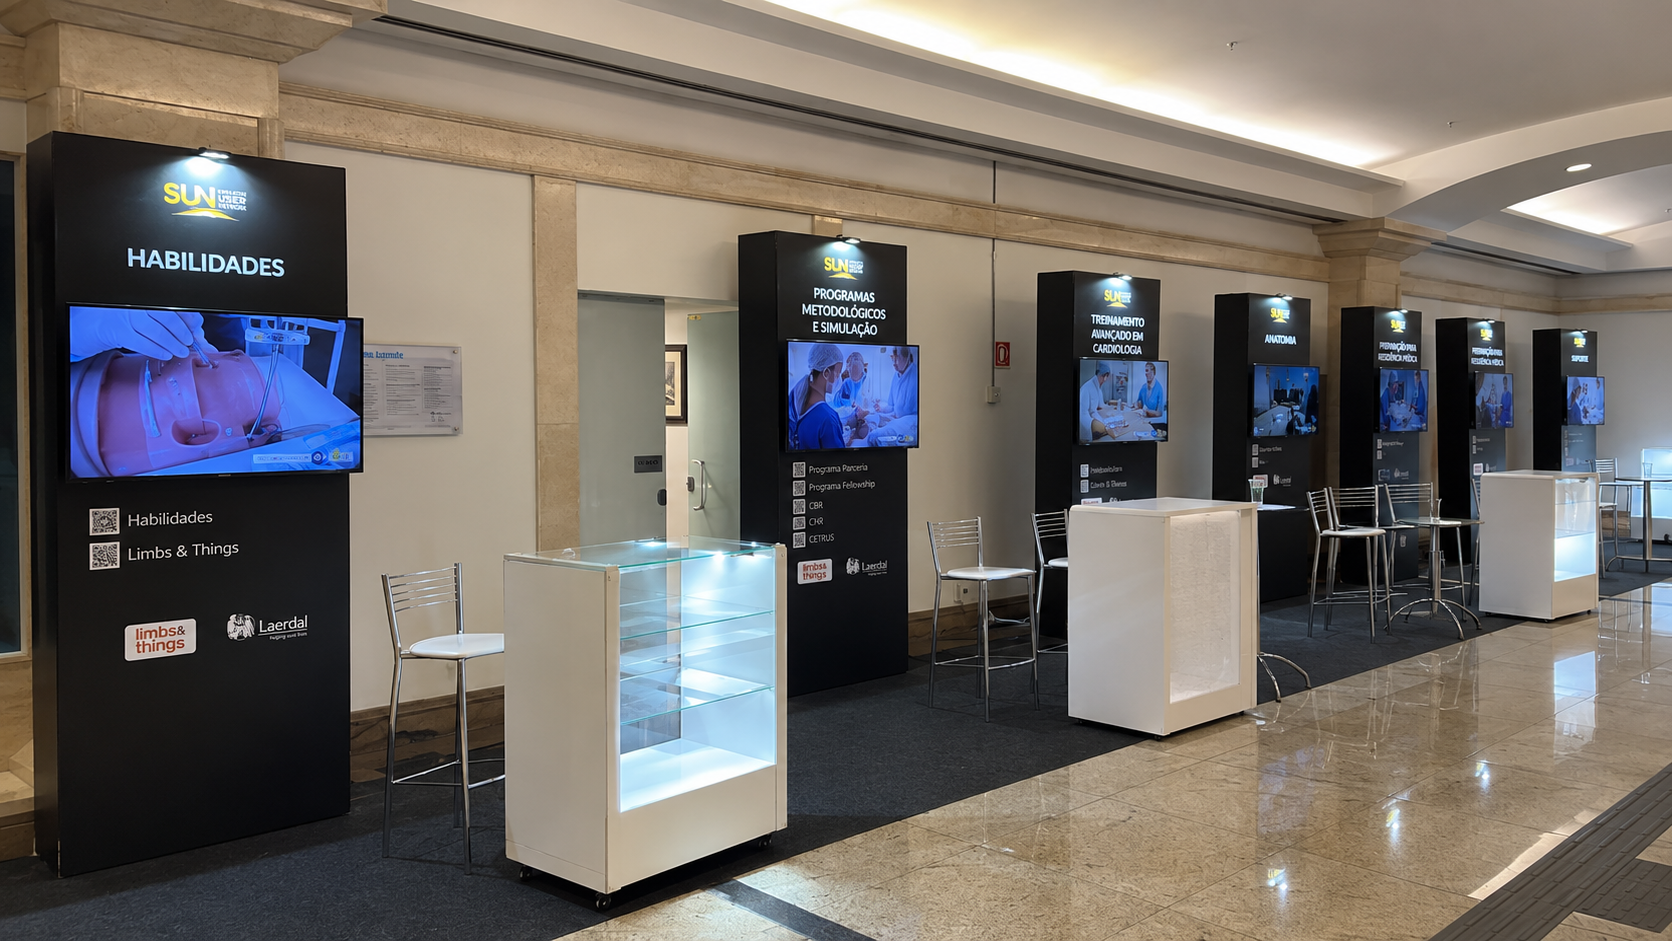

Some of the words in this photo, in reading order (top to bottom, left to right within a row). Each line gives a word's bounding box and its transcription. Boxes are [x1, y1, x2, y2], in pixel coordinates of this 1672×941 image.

[163, 182, 216, 209] SUN
[127, 247, 285, 277] HABILIDADES
[824, 256, 849, 273] SUN
[813, 287, 876, 303] PROGRAMAS
[801, 303, 887, 320] METODOLÓGICOS
[1090, 314, 1145, 328] TREINAMENTO
[812, 321, 819, 333] E
[820, 321, 878, 338] SIMULAÇÃO
[1091, 329, 1132, 343] AVANÇADO
[1132, 331, 1144, 342] EM
[1092, 343, 1143, 355] CARDIOLOGIA
[808, 465, 841, 476] Programa
[842, 462, 869, 472] Parceria
[808, 482, 841, 493] Programa
[842, 479, 876, 490] Fellowship
[808, 501, 824, 510] CBR
[127, 510, 213, 527] Habilidades
[808, 533, 835, 544] CETRUS
[127, 546, 173, 561] Limbs
[176, 545, 188, 558] &
[191, 542, 239, 557] Things
[259, 614, 308, 633] Laerdal
[135, 639, 185, 654] things
